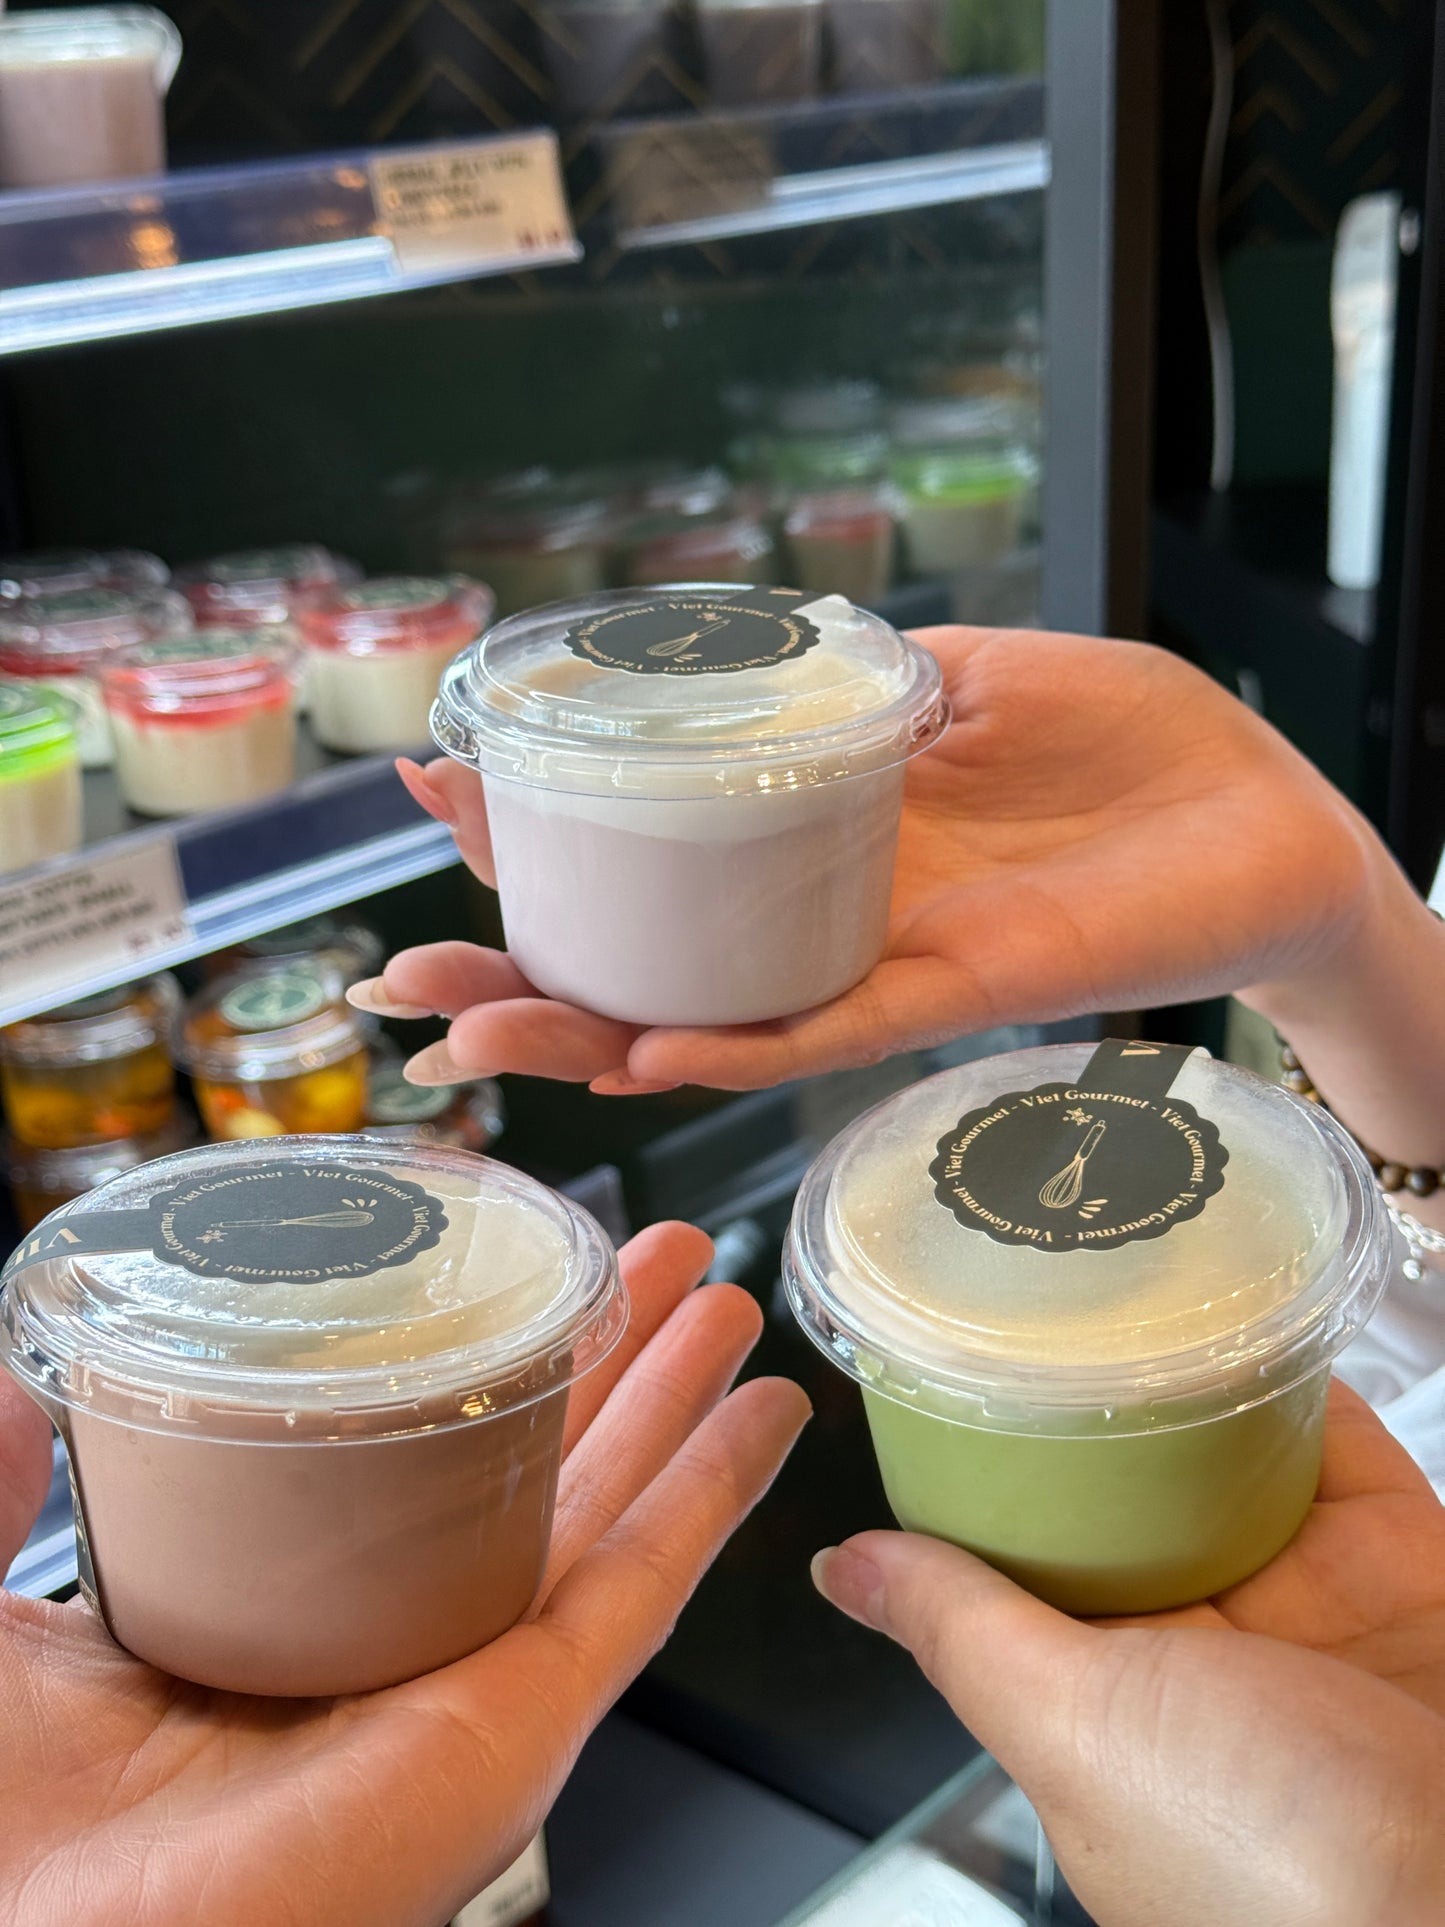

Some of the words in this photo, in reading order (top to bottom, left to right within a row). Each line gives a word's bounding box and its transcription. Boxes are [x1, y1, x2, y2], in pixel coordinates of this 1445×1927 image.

[706, 604, 774, 619] Gourmet
[1020, 1093, 1060, 1107] Viet
[1064, 1089, 1150, 1109] Gourmet
[1160, 1107, 1190, 1132] Viet
[951, 1108, 1010, 1153] Gourmet
[1183, 1129, 1206, 1183] Gourmet
[303, 1169, 341, 1178] Viet
[944, 1154, 964, 1179] Viet
[199, 1171, 282, 1192] Gourmet
[345, 1173, 415, 1201] Gourmet
[168, 1190, 203, 1205] Viet
[1162, 1192, 1198, 1215] Viet
[412, 1206, 429, 1224] Viet
[952, 1186, 1013, 1232] Gourmet
[1014, 1225, 1053, 1243] Viet
[1077, 1212, 1166, 1241] Gourmet
[377, 1224, 430, 1261] Gourmet
[178, 1249, 210, 1268] Viet
[325, 1262, 369, 1275] Viet
[224, 1265, 321, 1278] Gourmet
